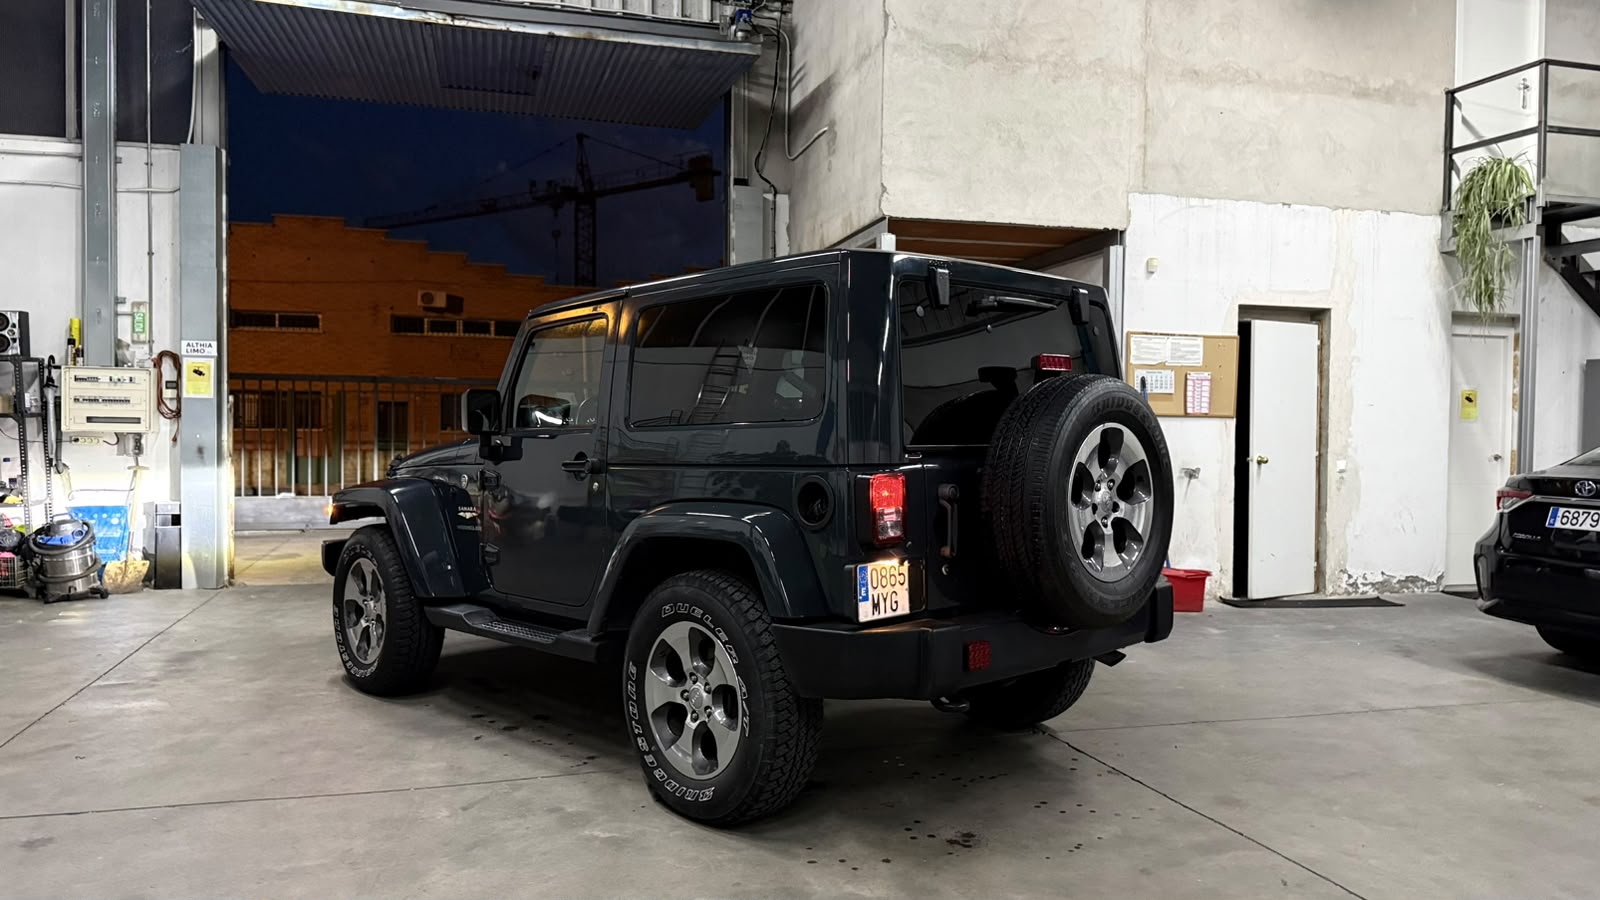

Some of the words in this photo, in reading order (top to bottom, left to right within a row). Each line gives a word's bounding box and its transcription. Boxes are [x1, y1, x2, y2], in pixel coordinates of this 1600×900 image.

[1560, 510, 1600, 528] 6879
[870, 565, 906, 589] 0865
[872, 590, 899, 616] MYG
[661, 602, 740, 665] DUELER
[626, 660, 716, 802] BRIDGESTONE
